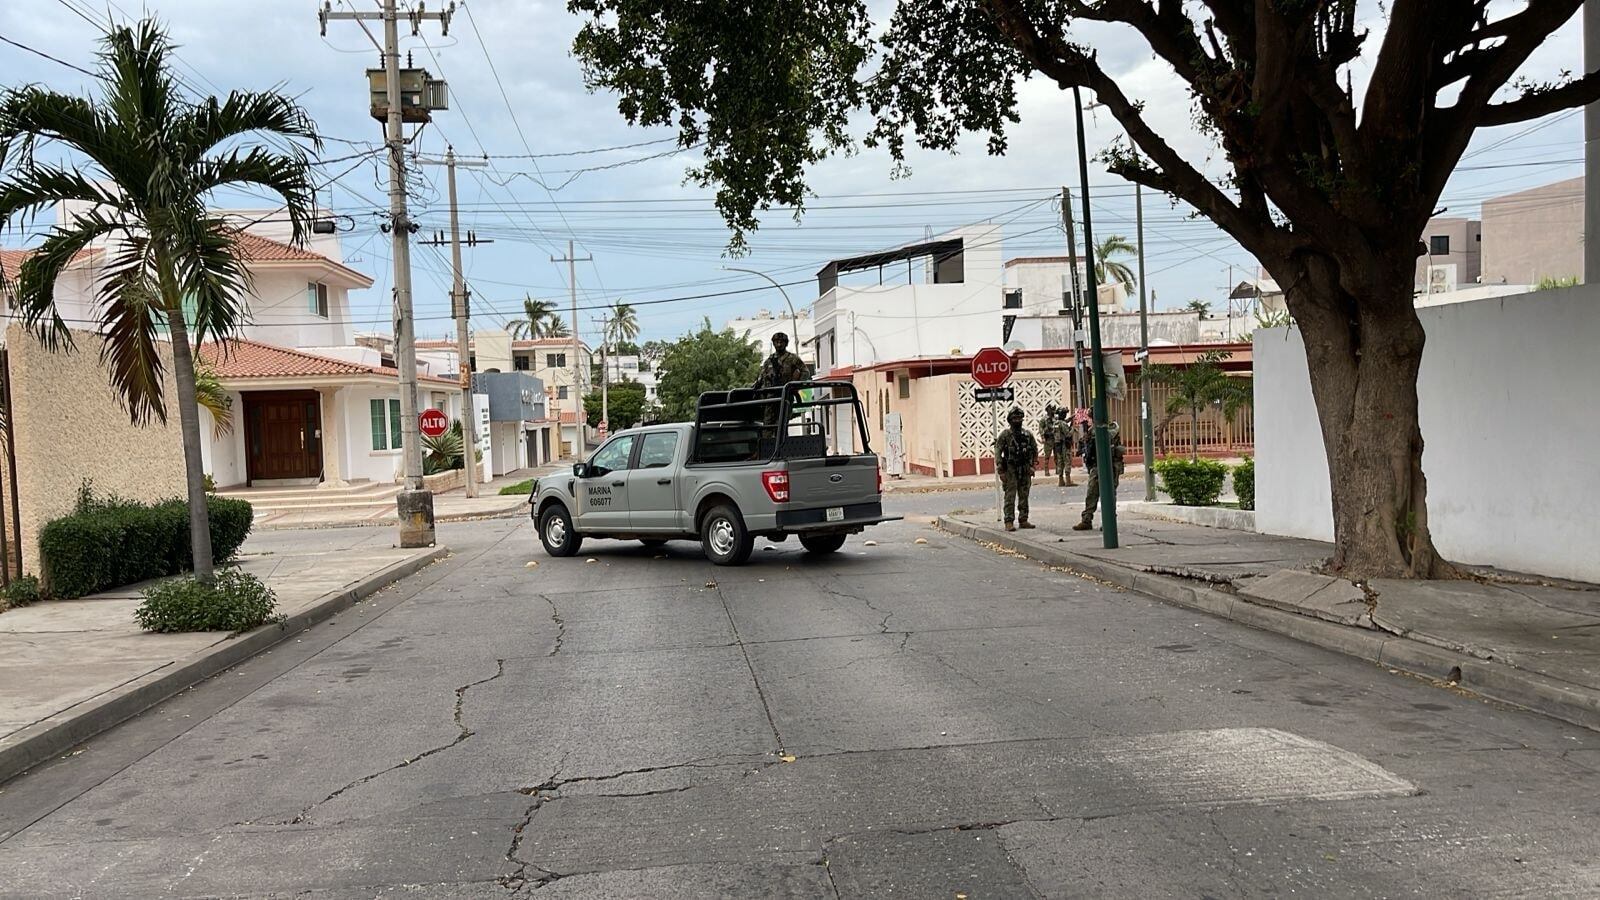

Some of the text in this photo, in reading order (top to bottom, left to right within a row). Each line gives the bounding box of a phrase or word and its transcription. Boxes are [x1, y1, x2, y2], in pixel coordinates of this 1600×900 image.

[975, 362, 1008, 374] ALTO
[422, 417, 446, 429] ALTO
[588, 486, 612, 495] MARINA
